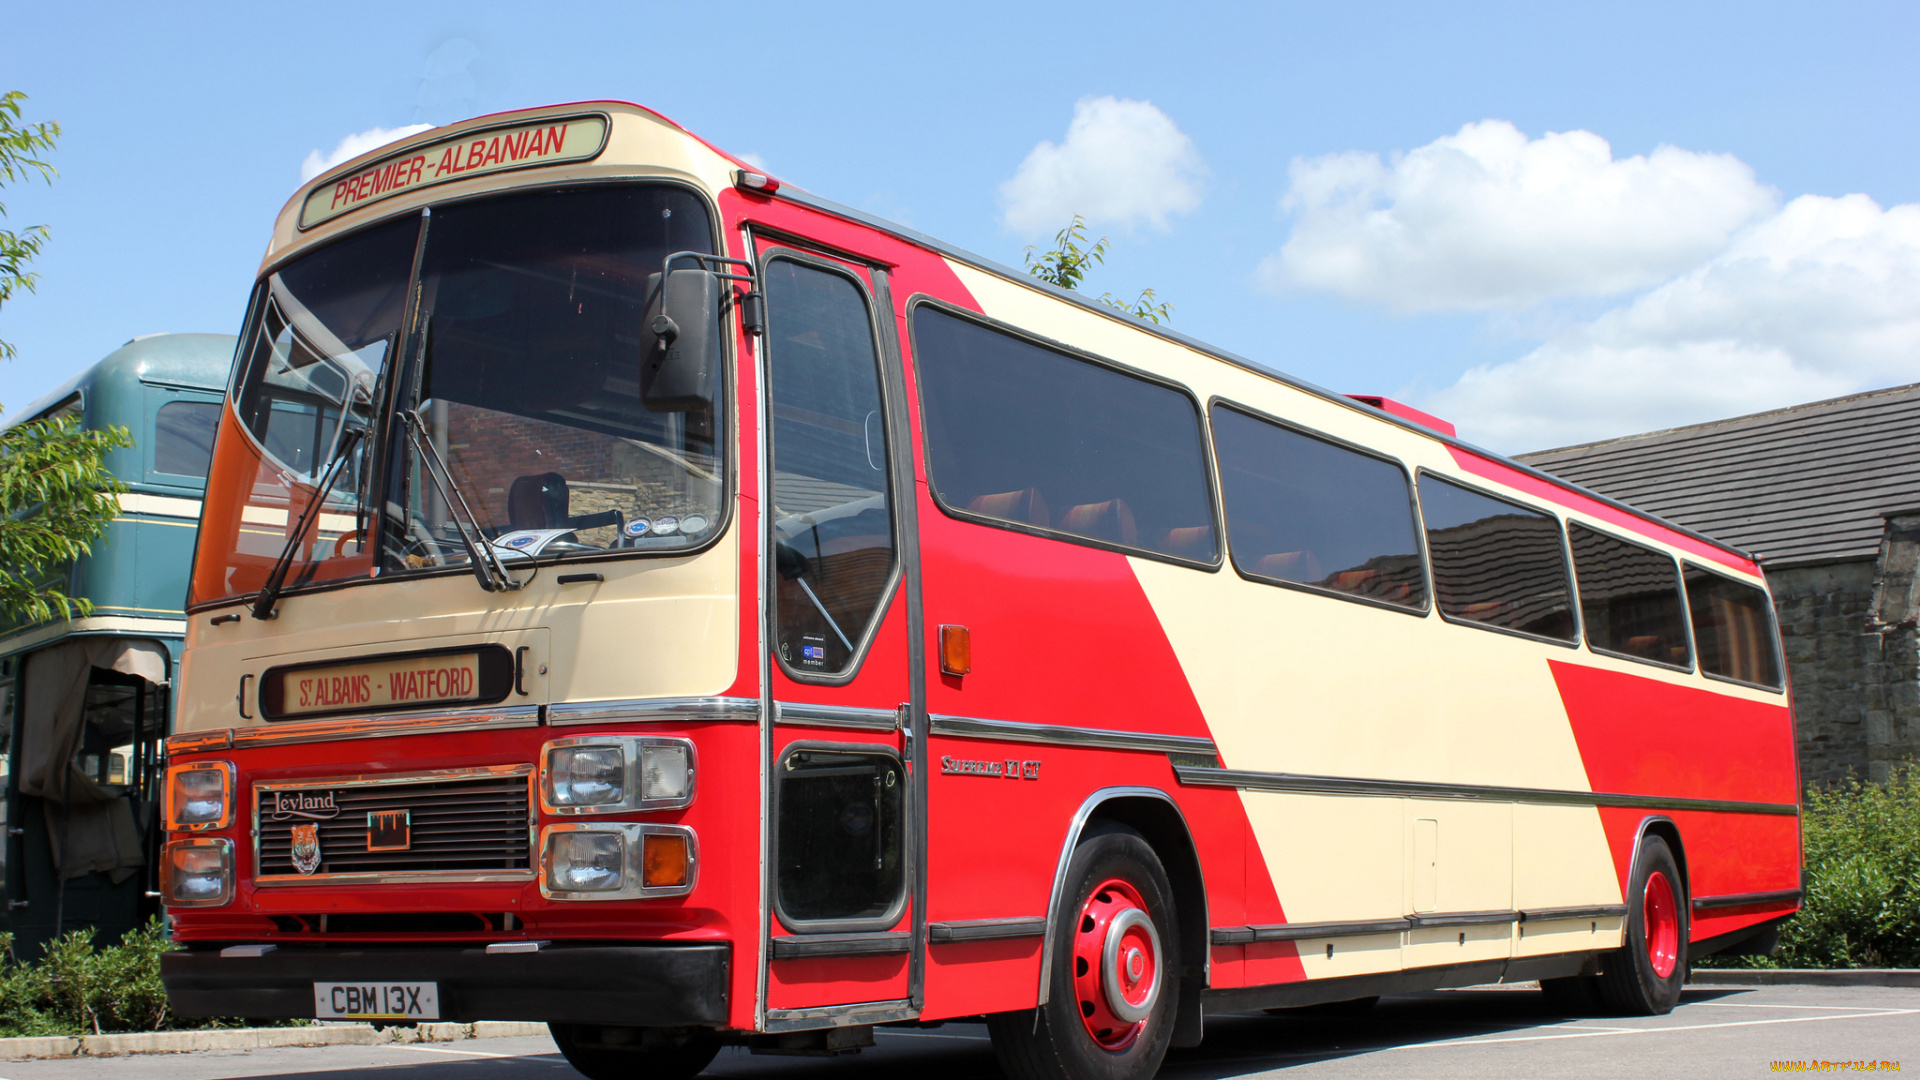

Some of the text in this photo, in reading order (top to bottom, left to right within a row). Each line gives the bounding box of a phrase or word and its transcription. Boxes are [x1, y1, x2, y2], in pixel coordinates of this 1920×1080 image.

[390, 667, 473, 701] WATFORD
[1022, 760, 1041, 778] GT
[271, 791, 339, 820] Leyland
